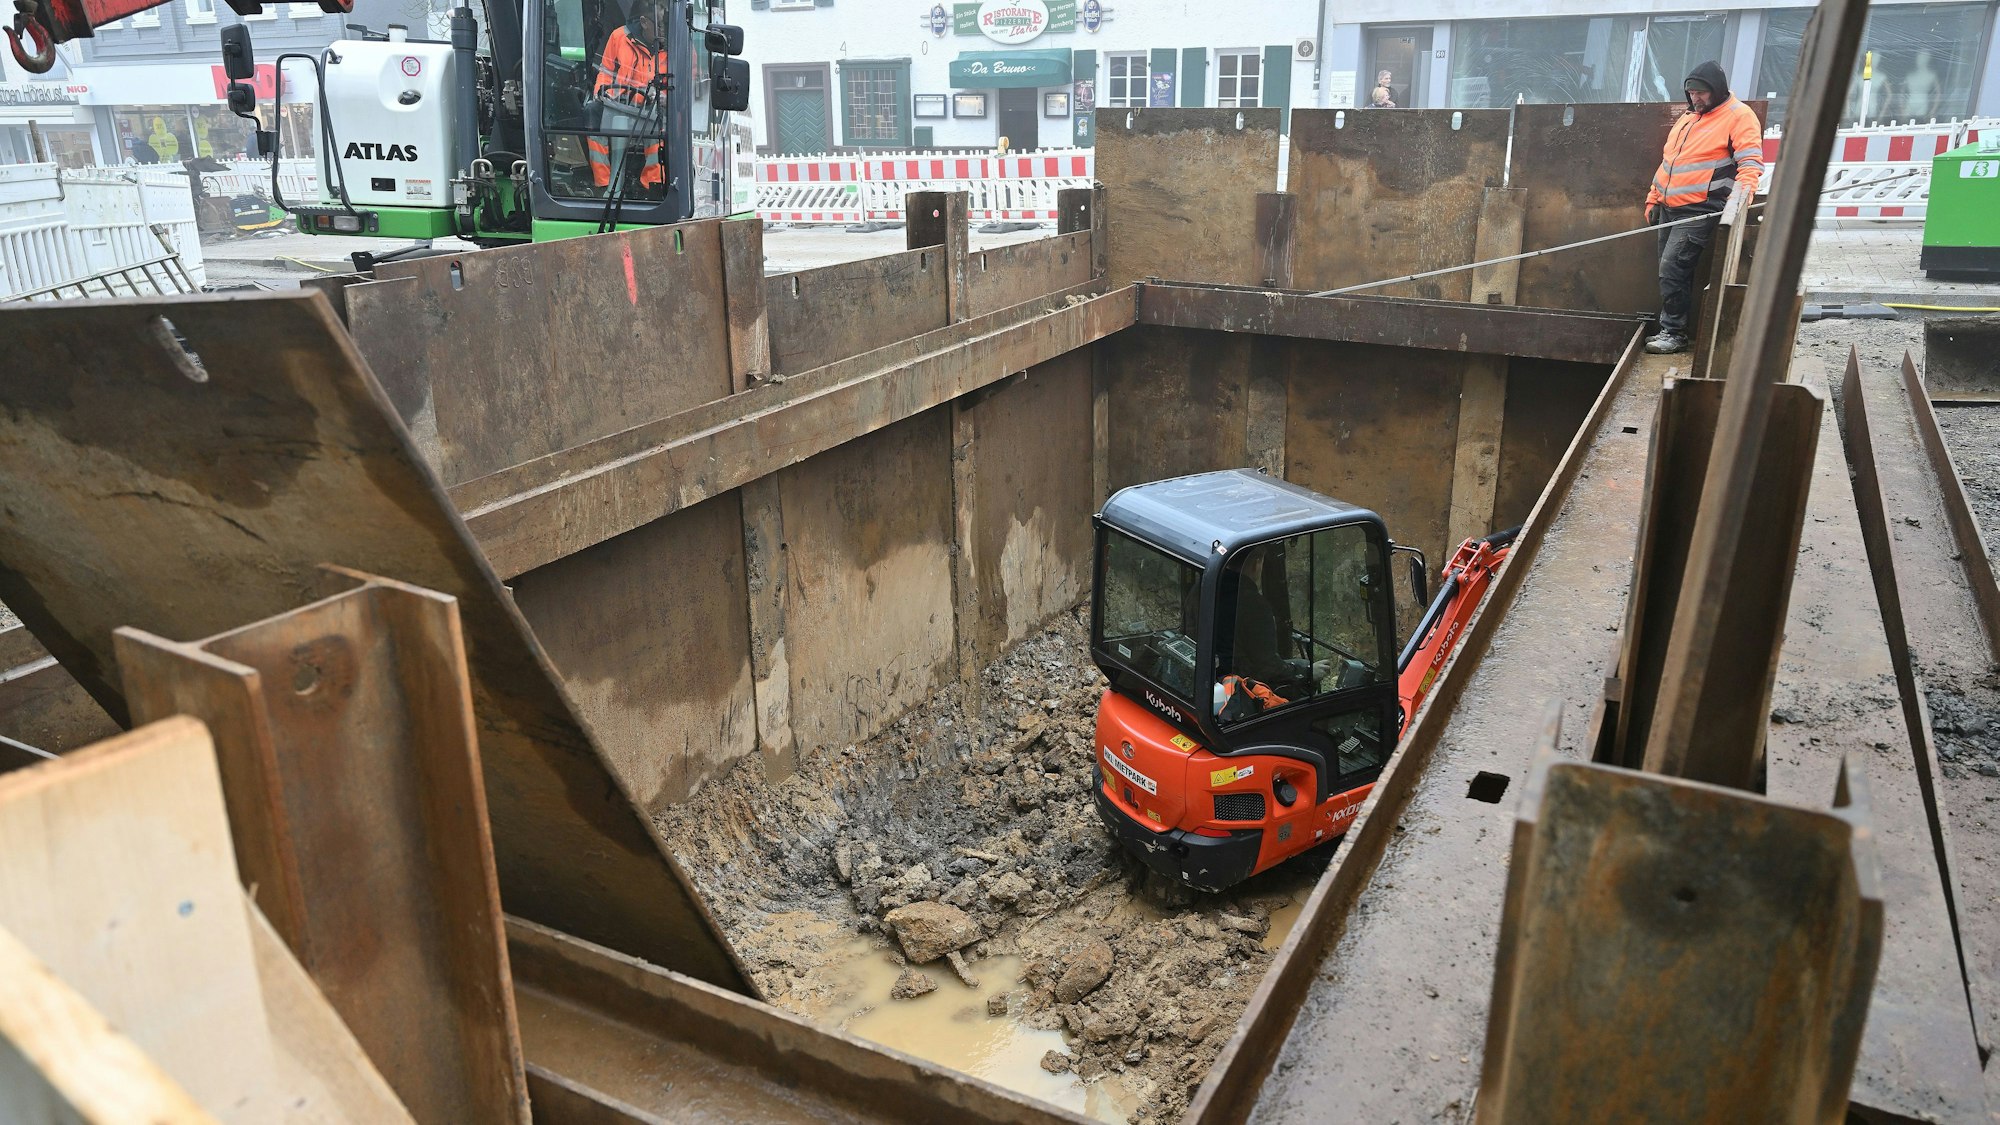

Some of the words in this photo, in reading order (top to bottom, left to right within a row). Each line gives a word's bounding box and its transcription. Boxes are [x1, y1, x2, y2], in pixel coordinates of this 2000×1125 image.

[983, 8, 1043, 26] RISTORANTE
[1051, 20, 1073, 29] Bensberg
[1009, 24, 1038, 37] Italia
[66, 85, 88, 93] NKD
[344, 142, 418, 162] ATLAS
[1433, 621, 1459, 666] Kubota
[1145, 690, 1182, 723] Kubota
[1114, 757, 1147, 789] MIETPARK
